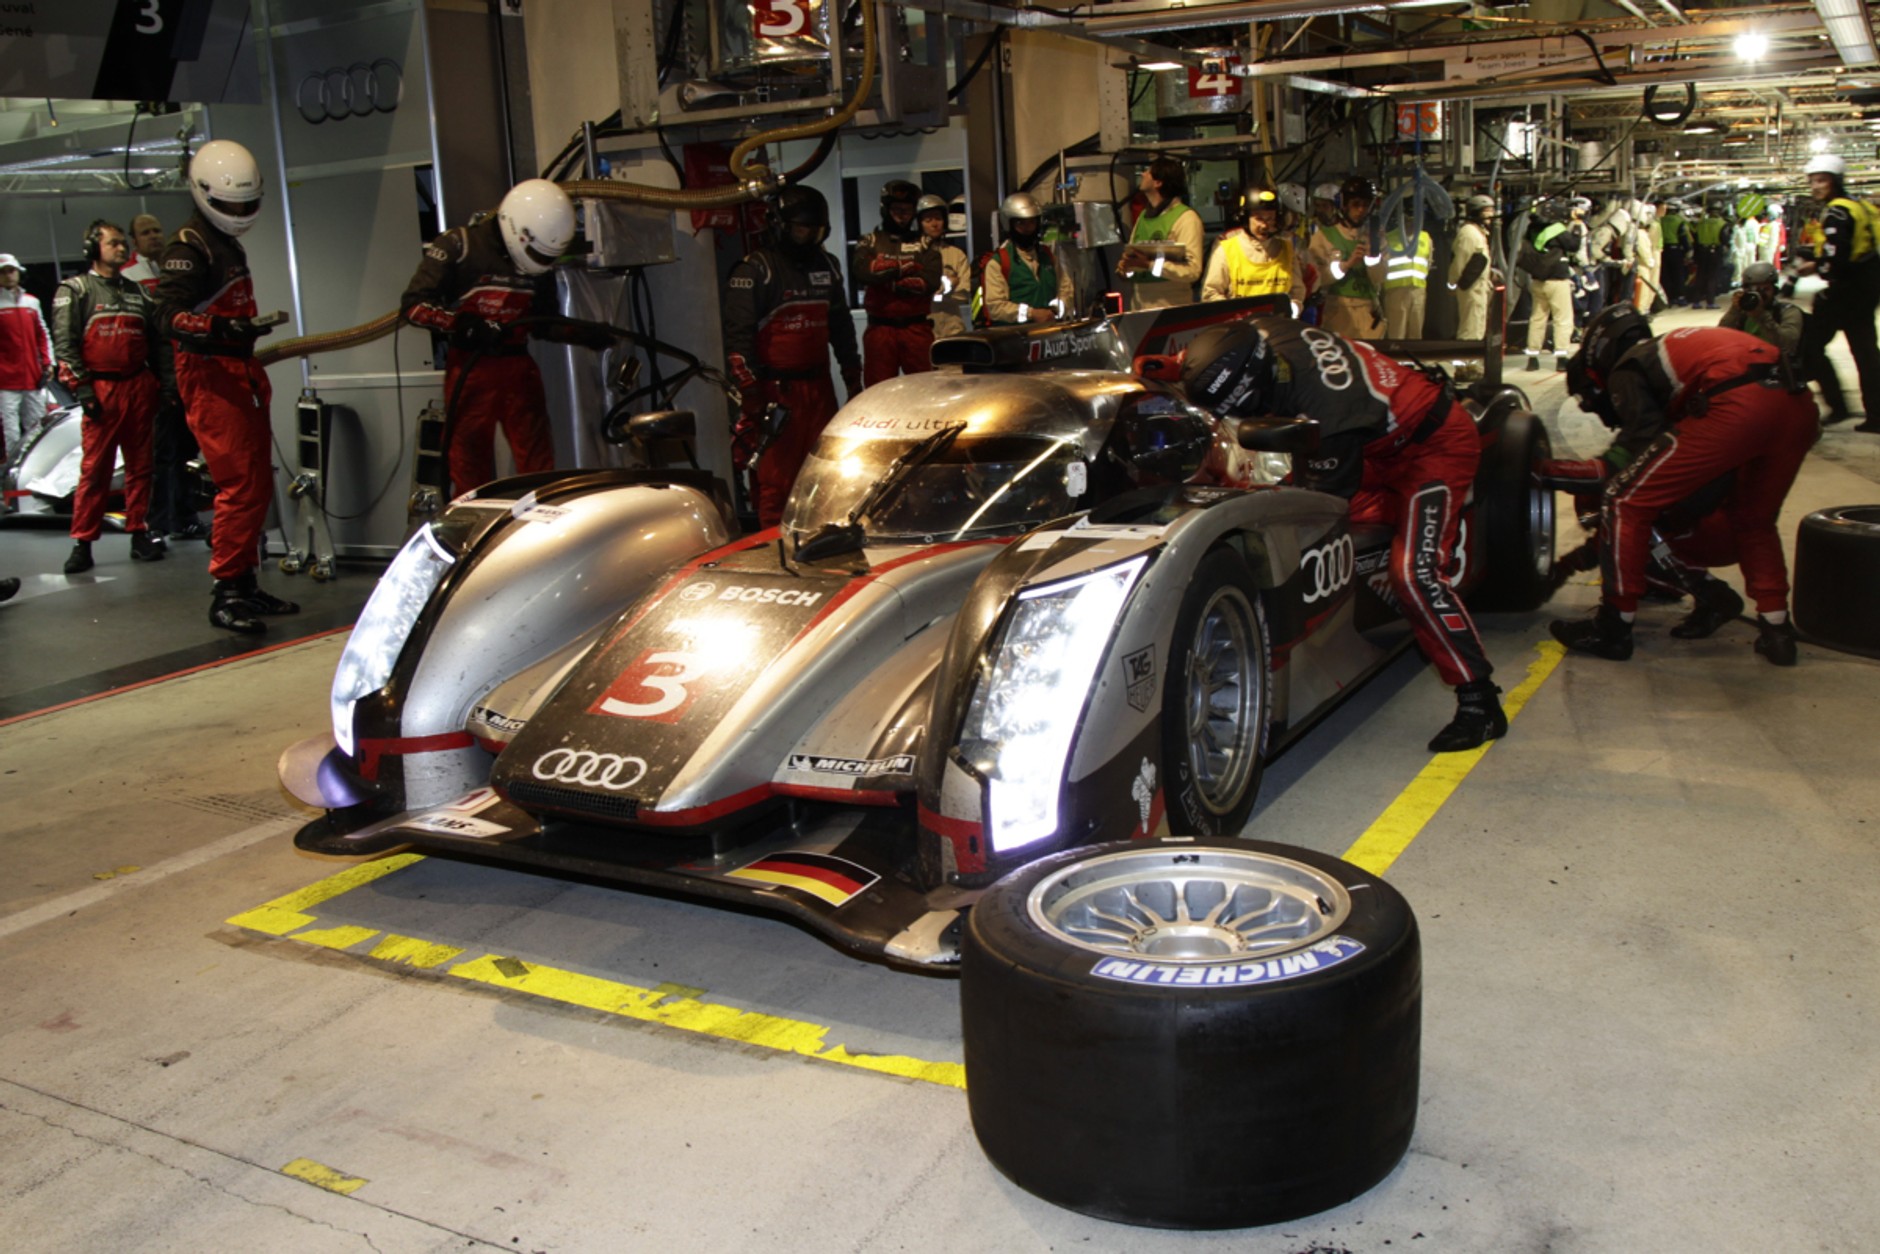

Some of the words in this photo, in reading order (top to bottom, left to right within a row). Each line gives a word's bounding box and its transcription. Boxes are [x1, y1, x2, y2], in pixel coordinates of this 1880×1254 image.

[134, 0, 165, 35] 3
[759, 0, 805, 37] 3
[1195, 72, 1234, 95] 4
[1044, 334, 1069, 359] Audi
[1069, 331, 1098, 356] Sport
[1206, 368, 1232, 396] uvex
[1215, 373, 1256, 415] uvex
[849, 416, 900, 430] Audi
[1416, 504, 1439, 567] Sport
[717, 585, 823, 607] BOSCH
[1416, 567, 1450, 609] Audi
[1128, 651, 1152, 681] TAG
[600, 651, 712, 717] 3
[815, 757, 911, 775] MICHELIN
[1099, 950, 1320, 984] MICHELIN
